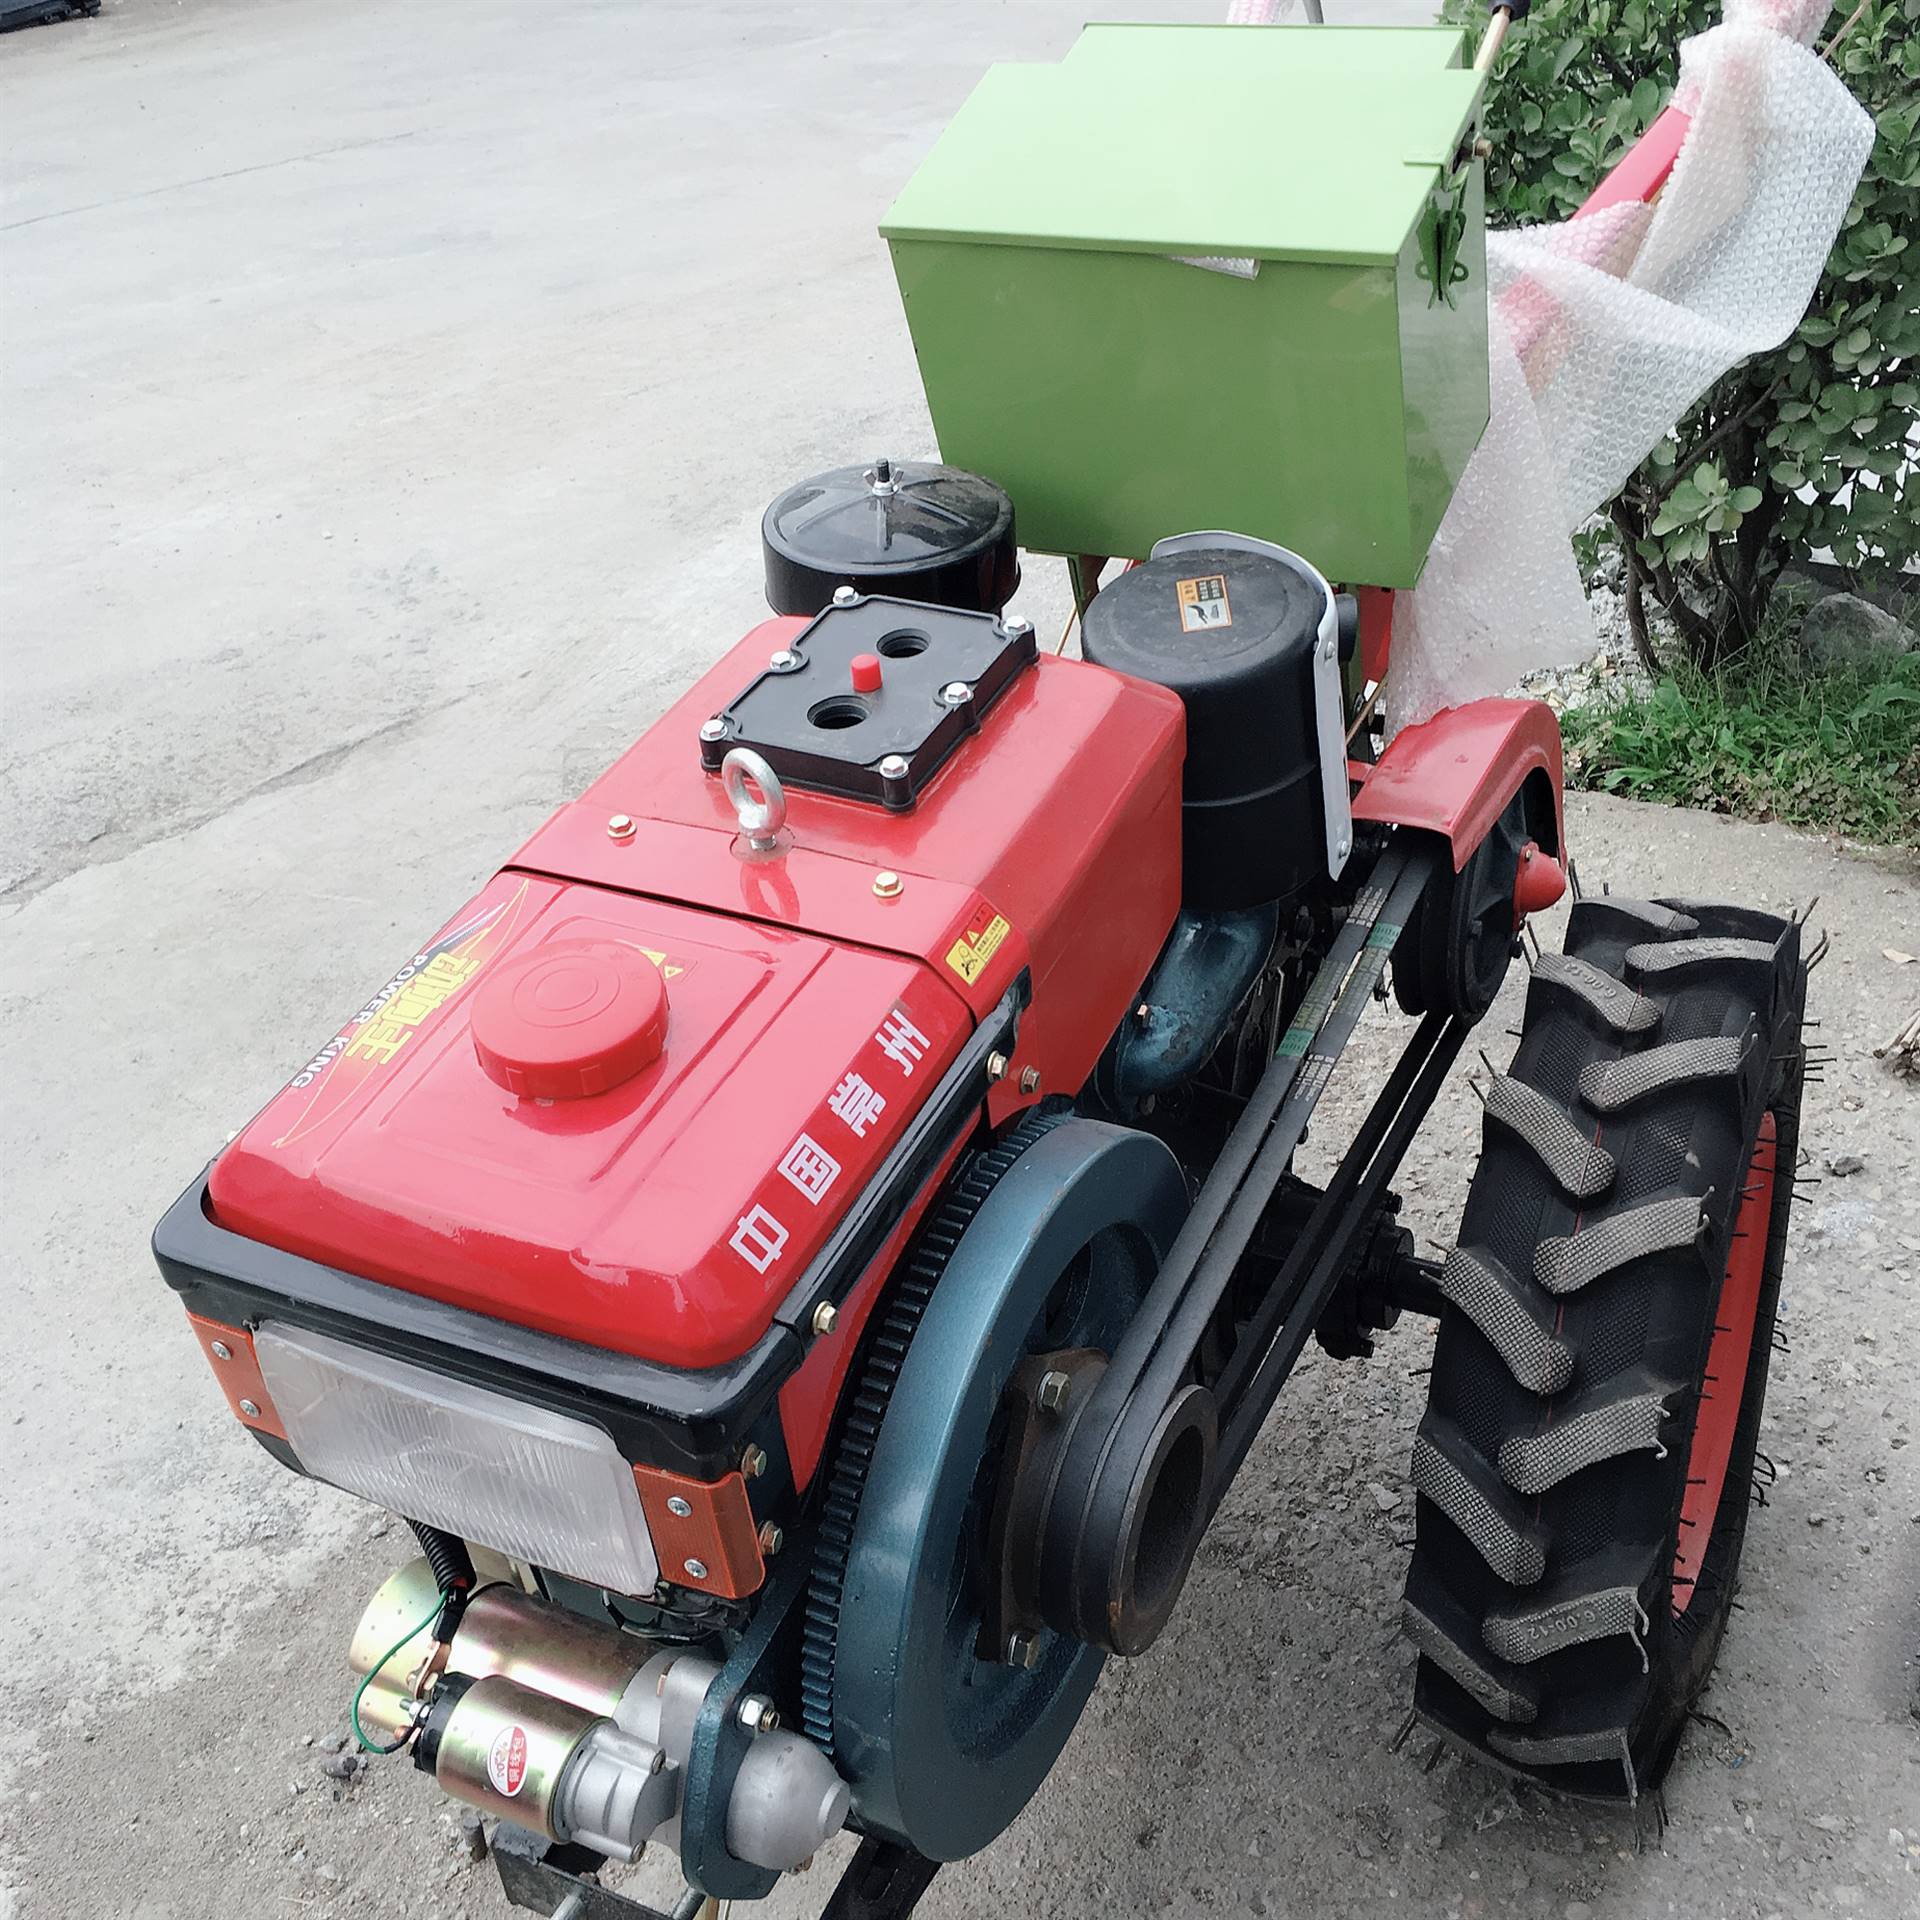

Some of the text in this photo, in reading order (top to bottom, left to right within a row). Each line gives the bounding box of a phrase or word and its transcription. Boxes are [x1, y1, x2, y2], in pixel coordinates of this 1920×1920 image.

[291, 954, 429, 1088] POWER KING
[346, 952, 481, 1065] 动力王
[728, 1009, 931, 1274] 中国常州
[1529, 1610, 1596, 1640] 6.00-12
